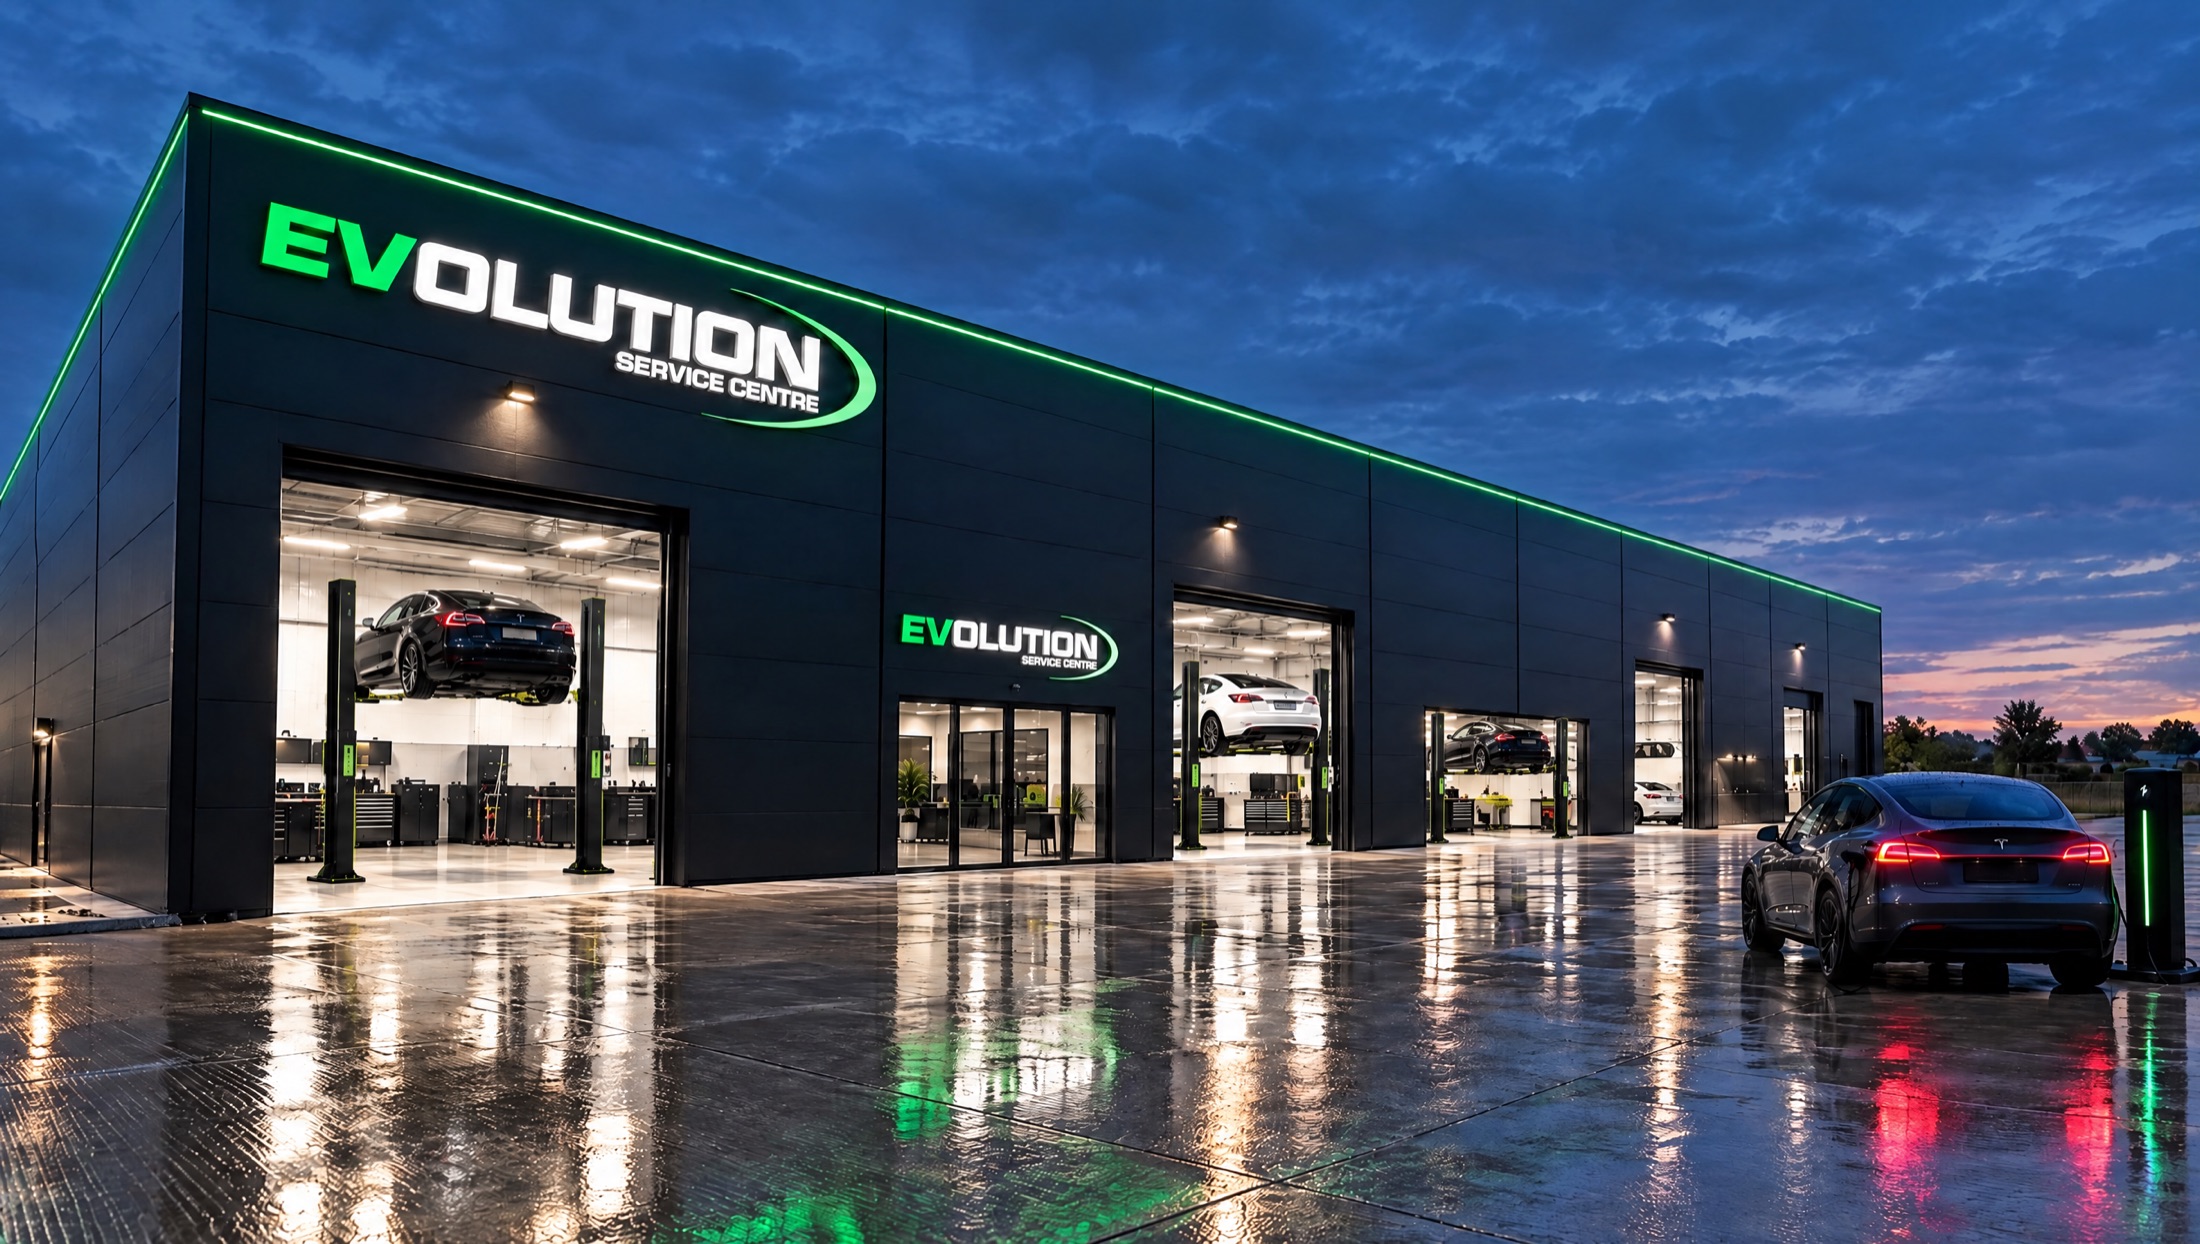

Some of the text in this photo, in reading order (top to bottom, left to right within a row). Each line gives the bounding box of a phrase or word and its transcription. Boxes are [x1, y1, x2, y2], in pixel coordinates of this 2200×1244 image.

[260, 201, 820, 392] EVOLUTION
[615, 350, 820, 414] SERVICE CENTRE
[901, 614, 1098, 660] EVOLUTION
[1021, 655, 1098, 671] SERVICE CENTRE
